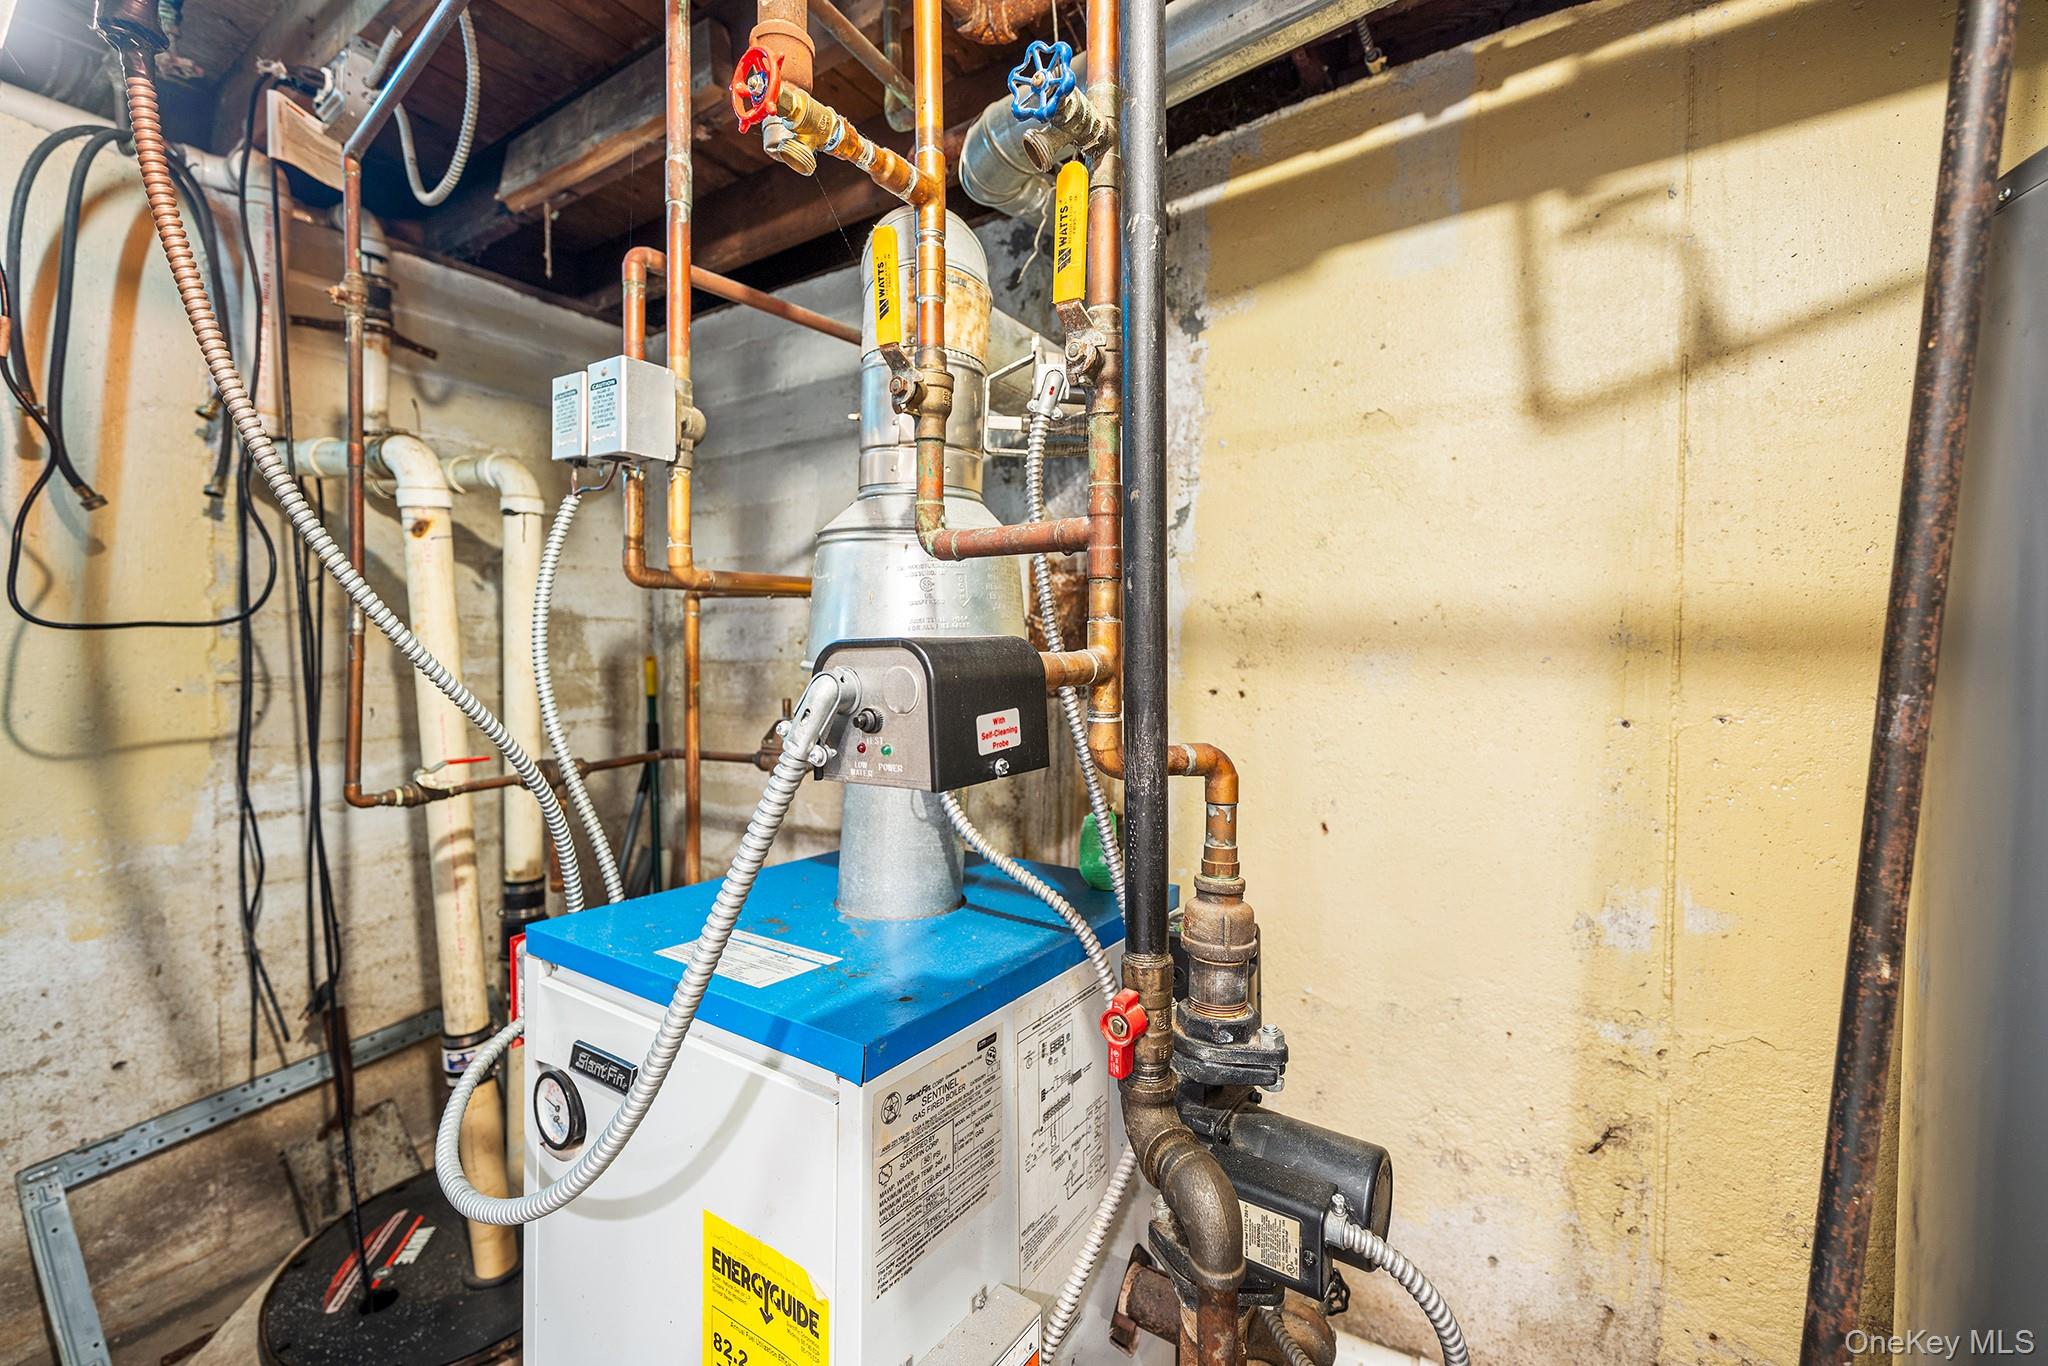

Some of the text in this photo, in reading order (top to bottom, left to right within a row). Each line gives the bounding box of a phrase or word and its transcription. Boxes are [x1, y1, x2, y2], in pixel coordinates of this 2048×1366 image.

[1059, 205, 1069, 247] WATTS
[877, 261, 886, 298] WATTS
[592, 380, 616, 390] CAUTION
[981, 726, 1018, 741] Self-Cleaning
[992, 716, 1006, 725] With
[992, 739, 1009, 750] Probe
[850, 768, 873, 778] WATER
[854, 760, 868, 769] LOW
[878, 763, 903, 774] POWER
[912, 1083, 967, 1123] GAS FIRED BOILER
[921, 1077, 960, 1107] SENTINEL
[901, 1133, 936, 1161] CERTIFIED BY
[879, 1187, 903, 1208] MAXIMUM
[902, 1174, 921, 1192] WATER
[897, 1170, 914, 1187] WATER
[879, 1198, 902, 1217] MINIMUM
[902, 1184, 919, 1201] RELIEF
[879, 1208, 897, 1224] VALVE
[895, 1192, 920, 1212] CAPACITY
[712, 1246, 820, 1340] ENERGYGUIDE
[713, 1331, 748, 1366] 82.2
